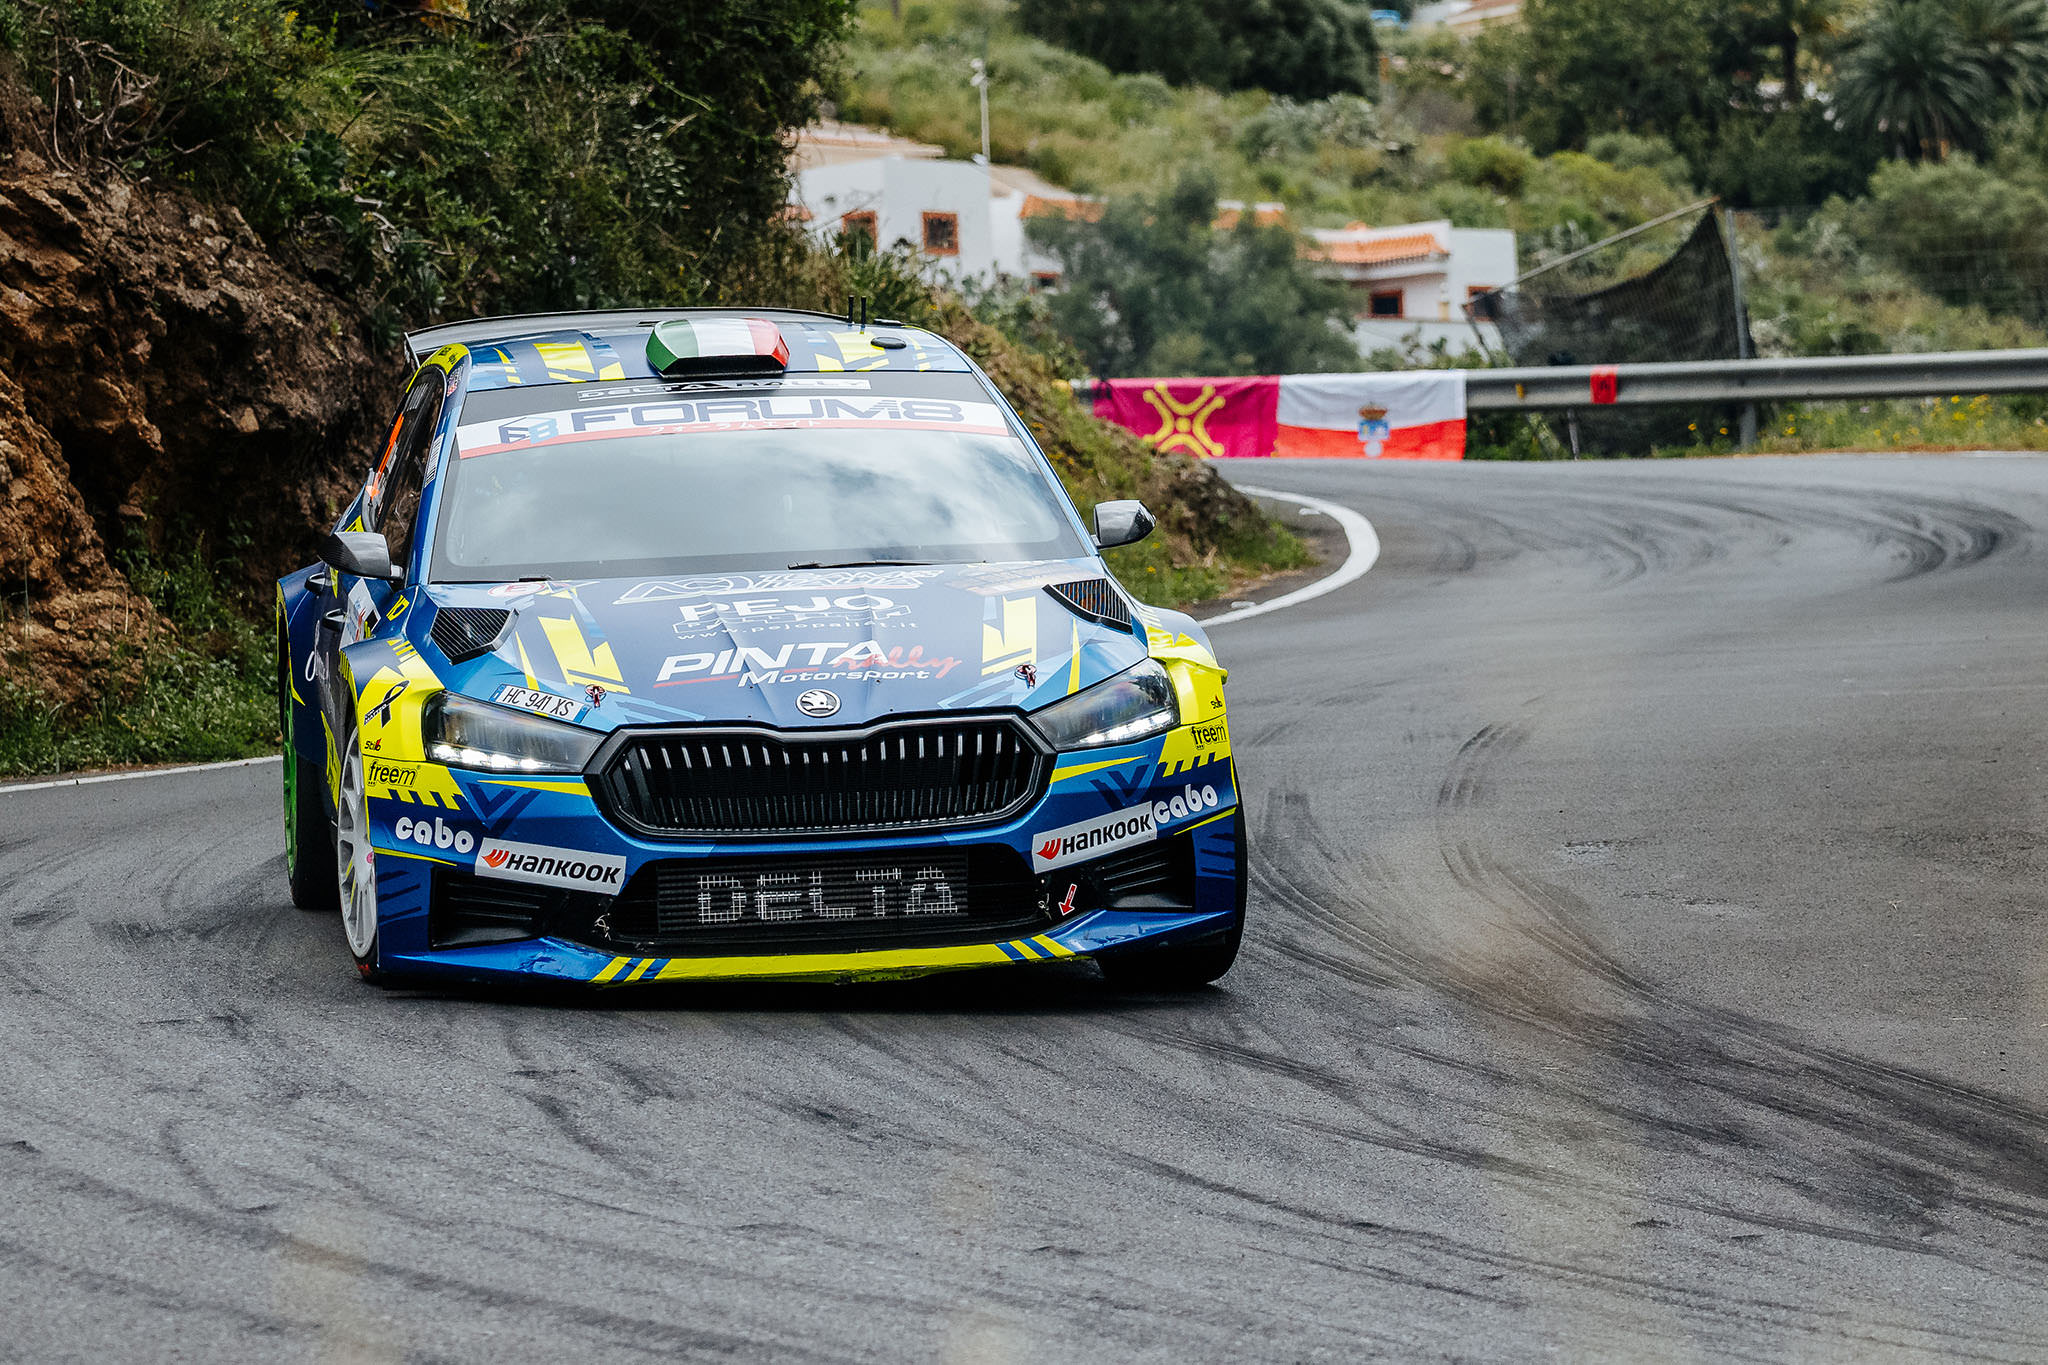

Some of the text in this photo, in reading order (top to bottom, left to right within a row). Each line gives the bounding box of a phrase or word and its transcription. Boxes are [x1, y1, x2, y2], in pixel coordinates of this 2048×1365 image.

[571, 398, 966, 432] FORUM8
[678, 594, 895, 622] PEJO
[656, 640, 889, 682] PINTA
[738, 669, 930, 687] Motorsport
[502, 687, 574, 716] HC 941 XS
[1191, 725, 1228, 745] freem
[368, 760, 416, 786] freem
[1153, 783, 1219, 825] cabo
[395, 816, 475, 854] cabo
[697, 866, 959, 925] DELTA
